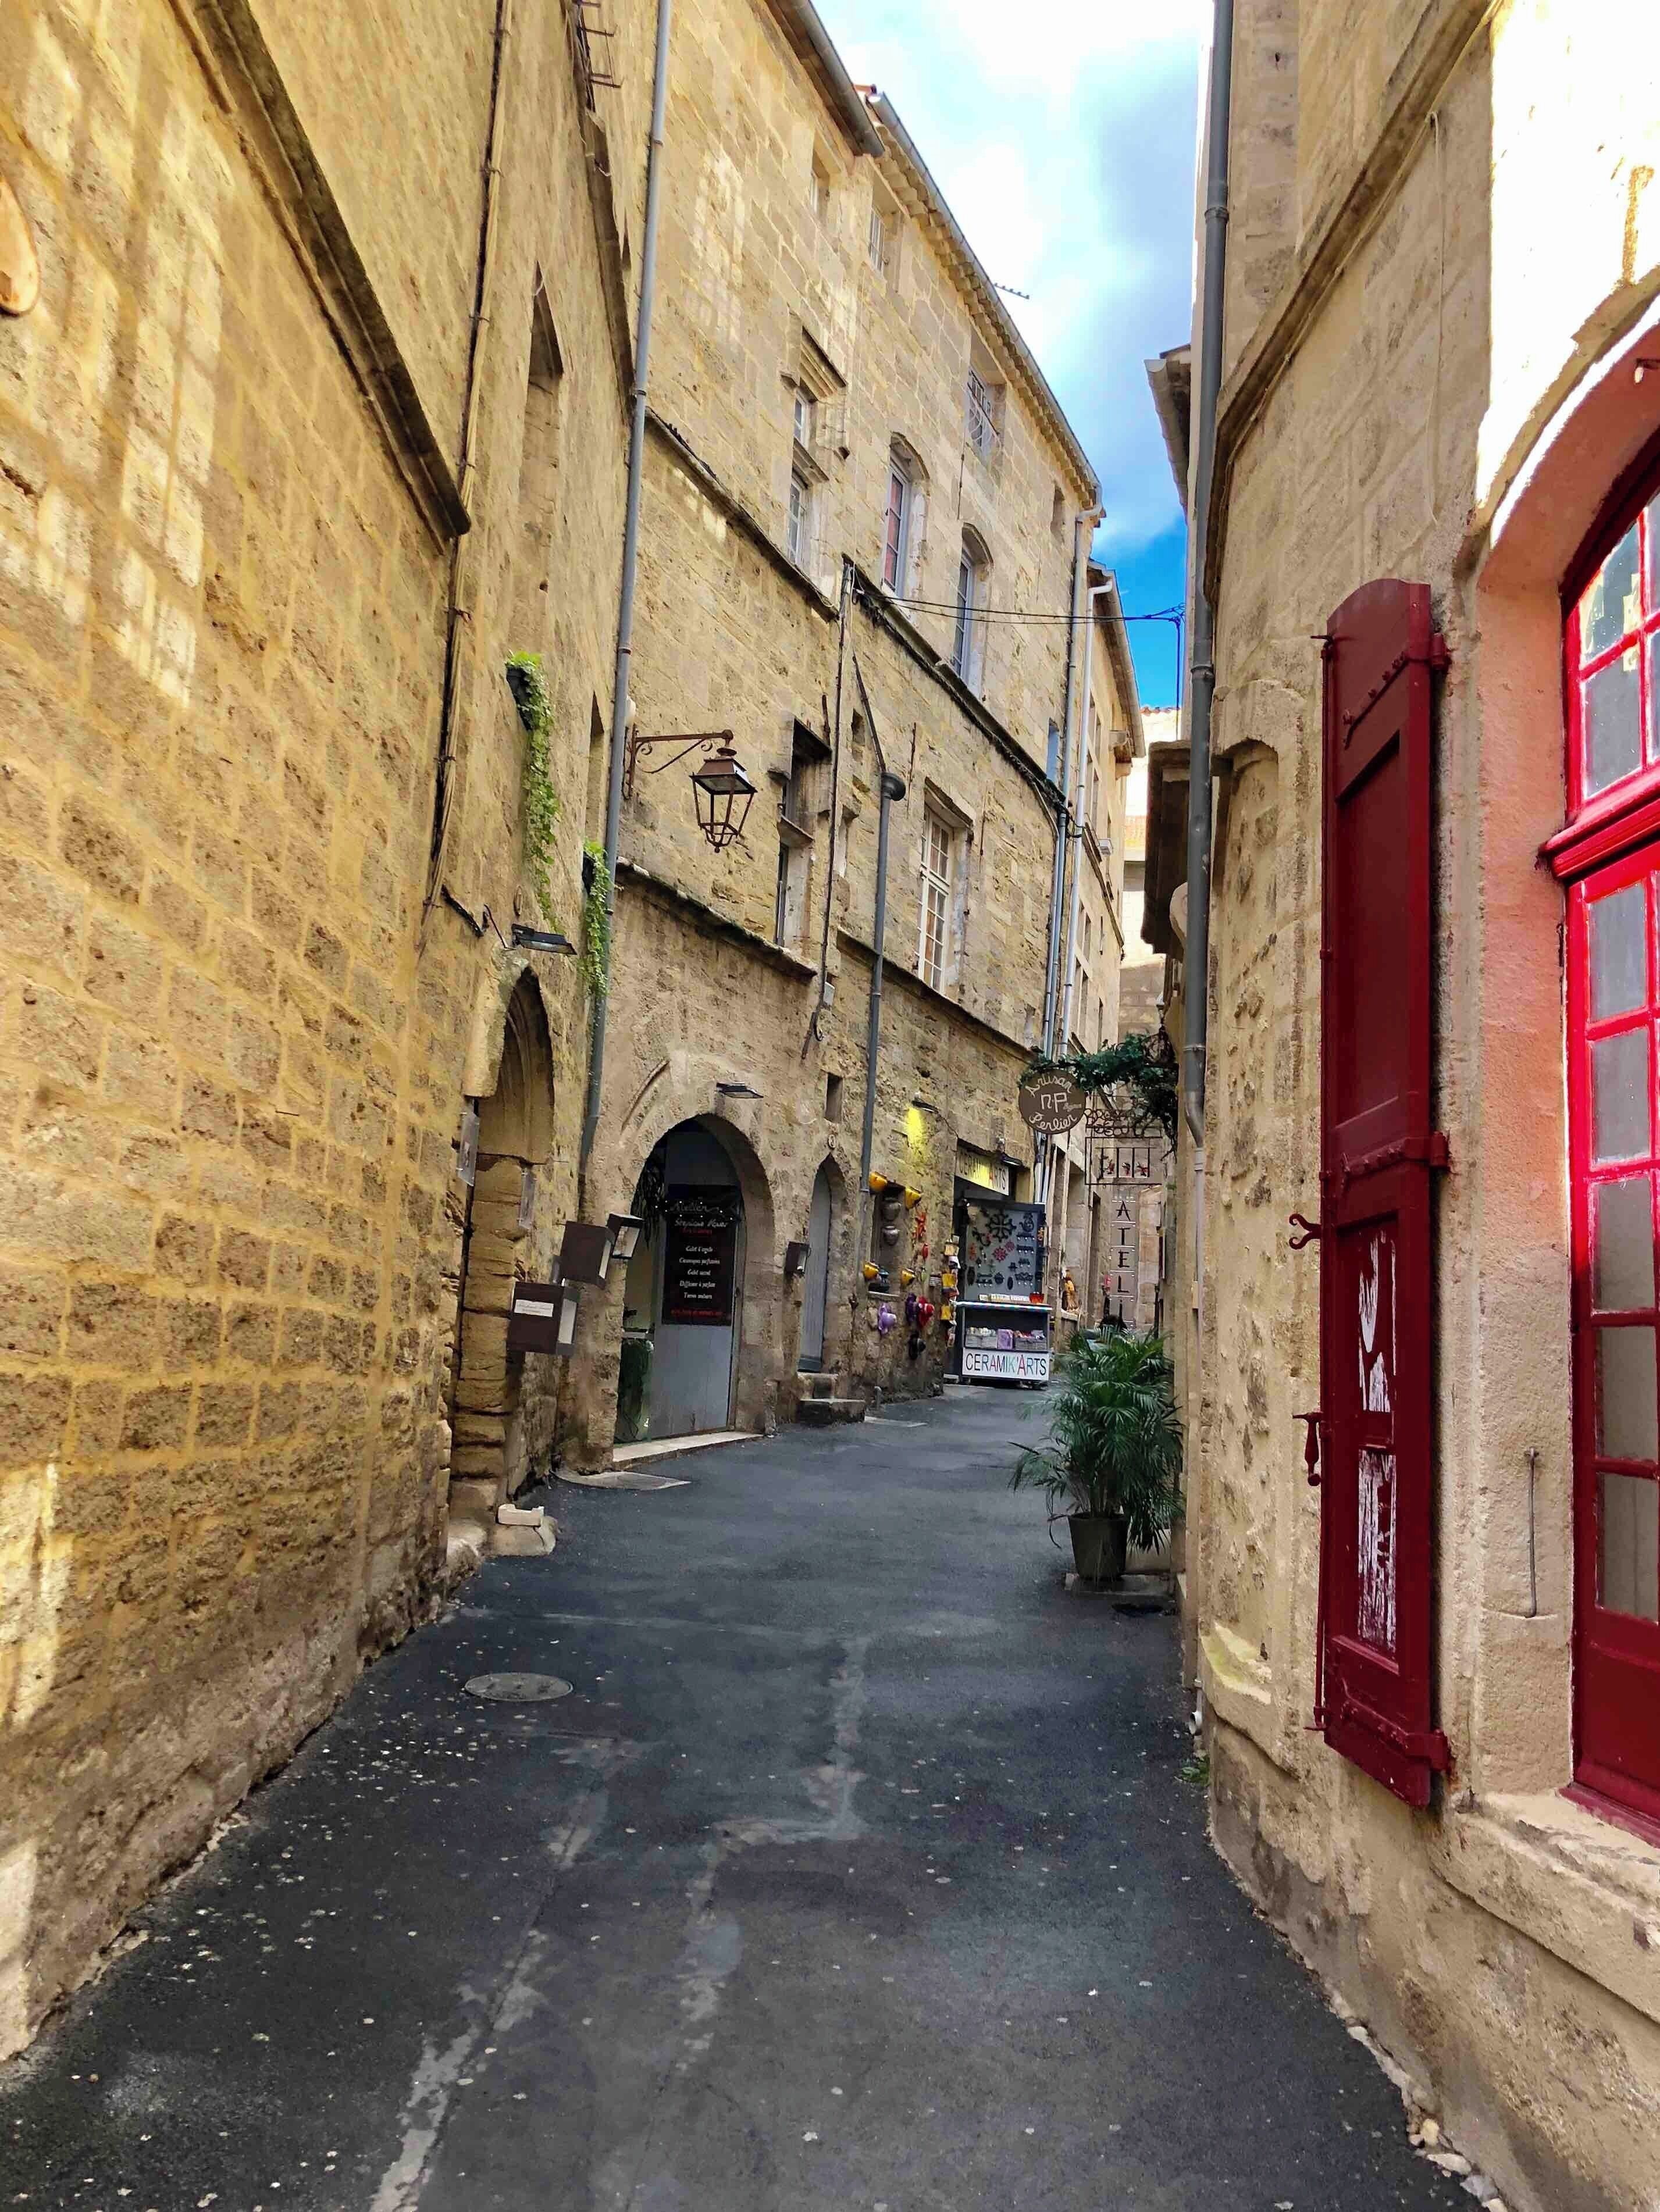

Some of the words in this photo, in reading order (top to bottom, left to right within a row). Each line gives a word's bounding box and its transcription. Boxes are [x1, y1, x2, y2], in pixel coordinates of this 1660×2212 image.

[1025, 1073, 1072, 1098] Artisan
[1029, 1112, 1077, 1131] Perlier
[966, 1353, 1047, 1376] CERAMIK'ARTS
